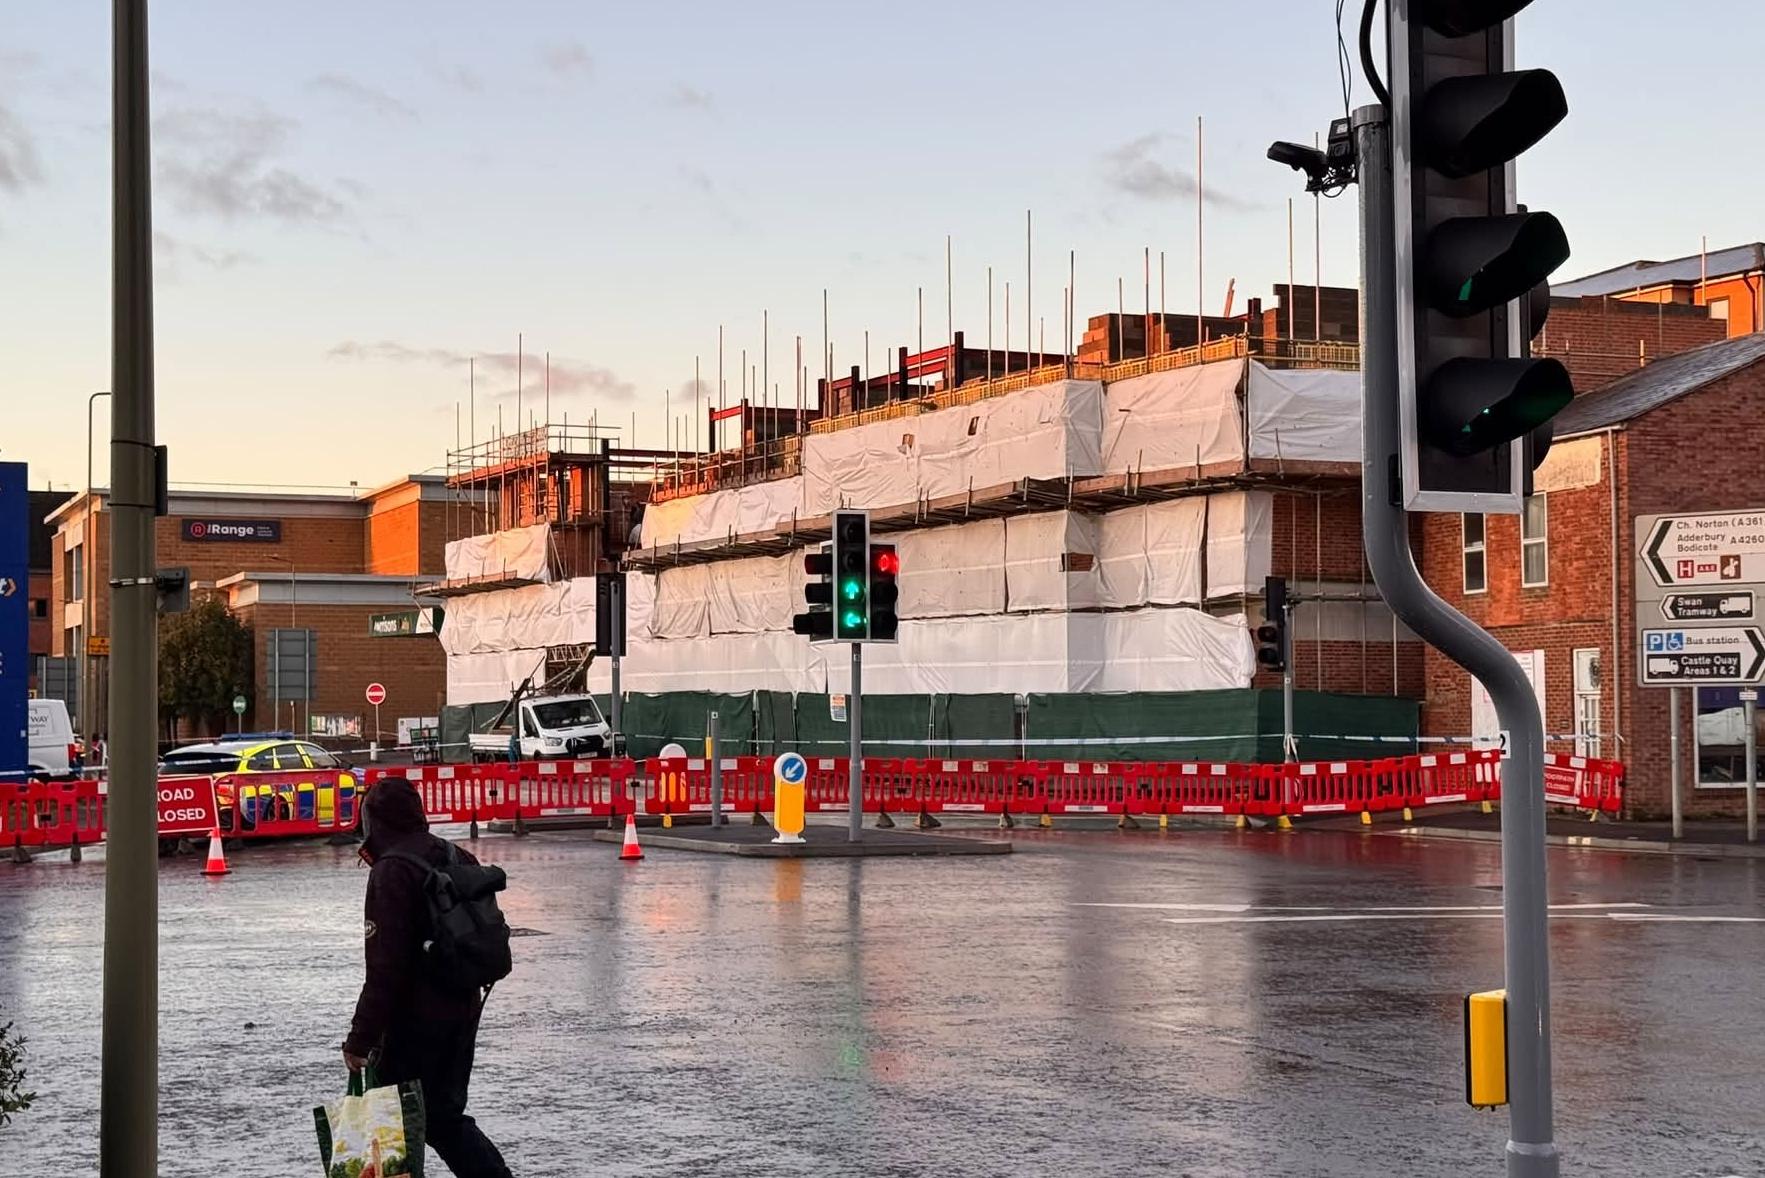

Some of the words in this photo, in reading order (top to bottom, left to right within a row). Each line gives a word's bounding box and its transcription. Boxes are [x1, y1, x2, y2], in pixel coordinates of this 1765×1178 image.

[1696, 520, 1729, 529] Norton
[1731, 516, 1765, 527] (A361
[212, 524, 254, 537] Range
[1678, 533, 1726, 542] Adderbury
[1730, 535, 1765, 545] A4260
[1679, 561, 1693, 577] H
[1677, 597, 1702, 607] Swan
[1677, 607, 1717, 617] Tramway
[1686, 637, 1704, 645] Bus
[1706, 636, 1739, 645] station
[1680, 656, 1711, 665] Castle
[1713, 655, 1738, 665] Quay
[1684, 667, 1710, 675] Areas
[1719, 666, 1727, 675] &
[1729, 666, 1736, 675] 2
[158, 807, 206, 822] LOSED
